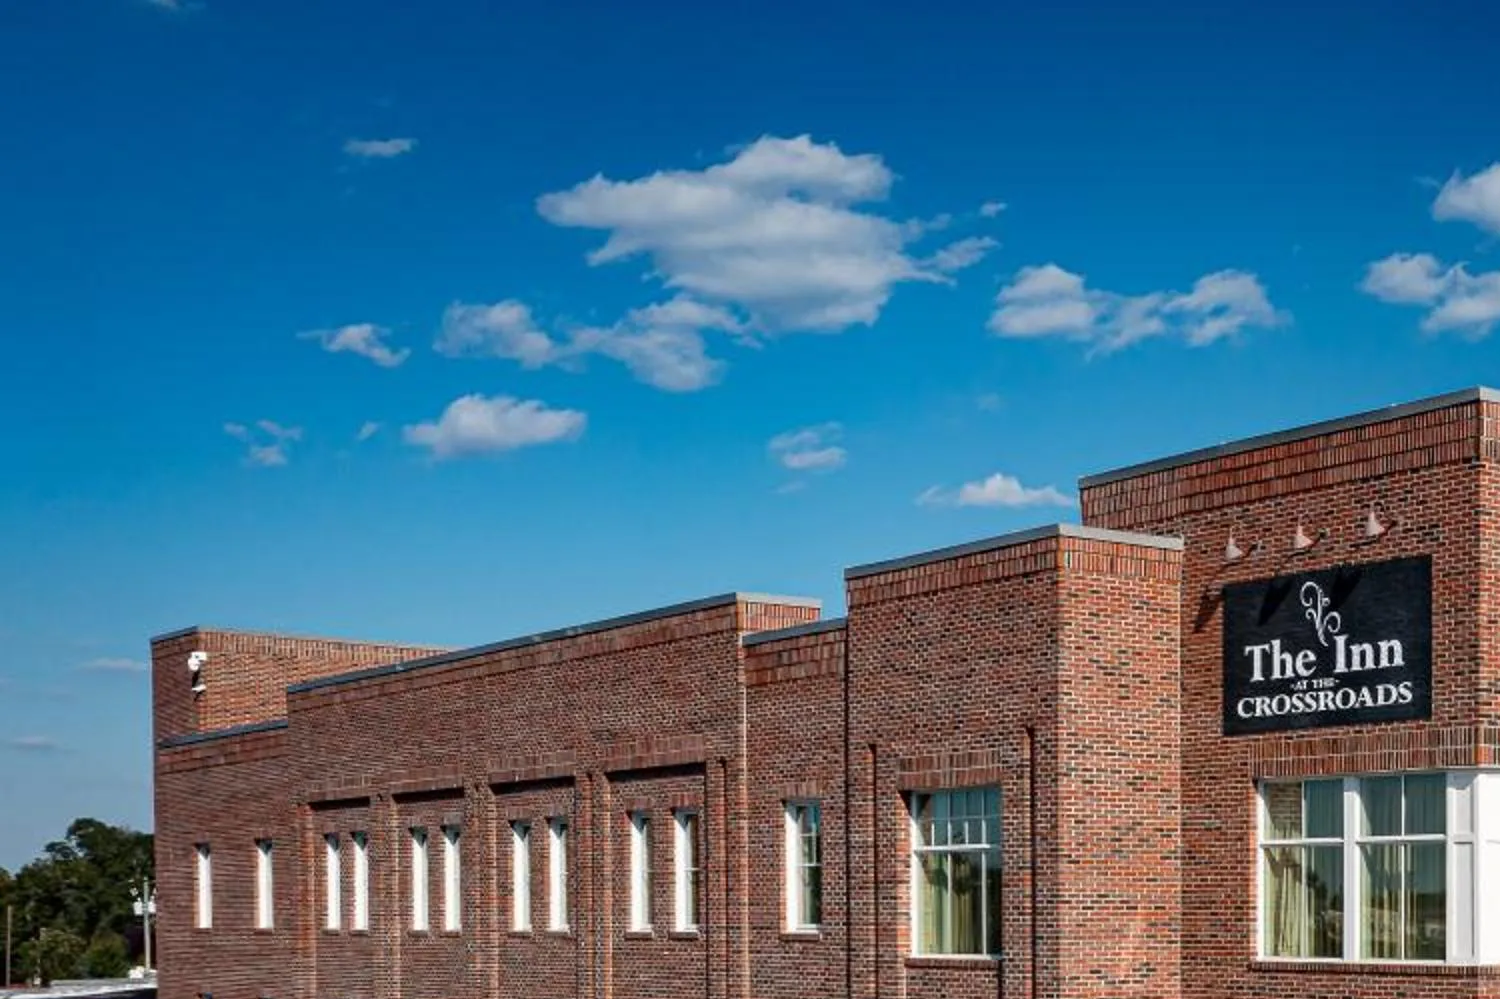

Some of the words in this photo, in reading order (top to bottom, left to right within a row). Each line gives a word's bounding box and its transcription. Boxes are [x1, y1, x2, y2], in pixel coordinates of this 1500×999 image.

[1243, 639, 1317, 682] The
[1333, 634, 1405, 673] Inn
[1236, 681, 1413, 718] CROSSROADS
